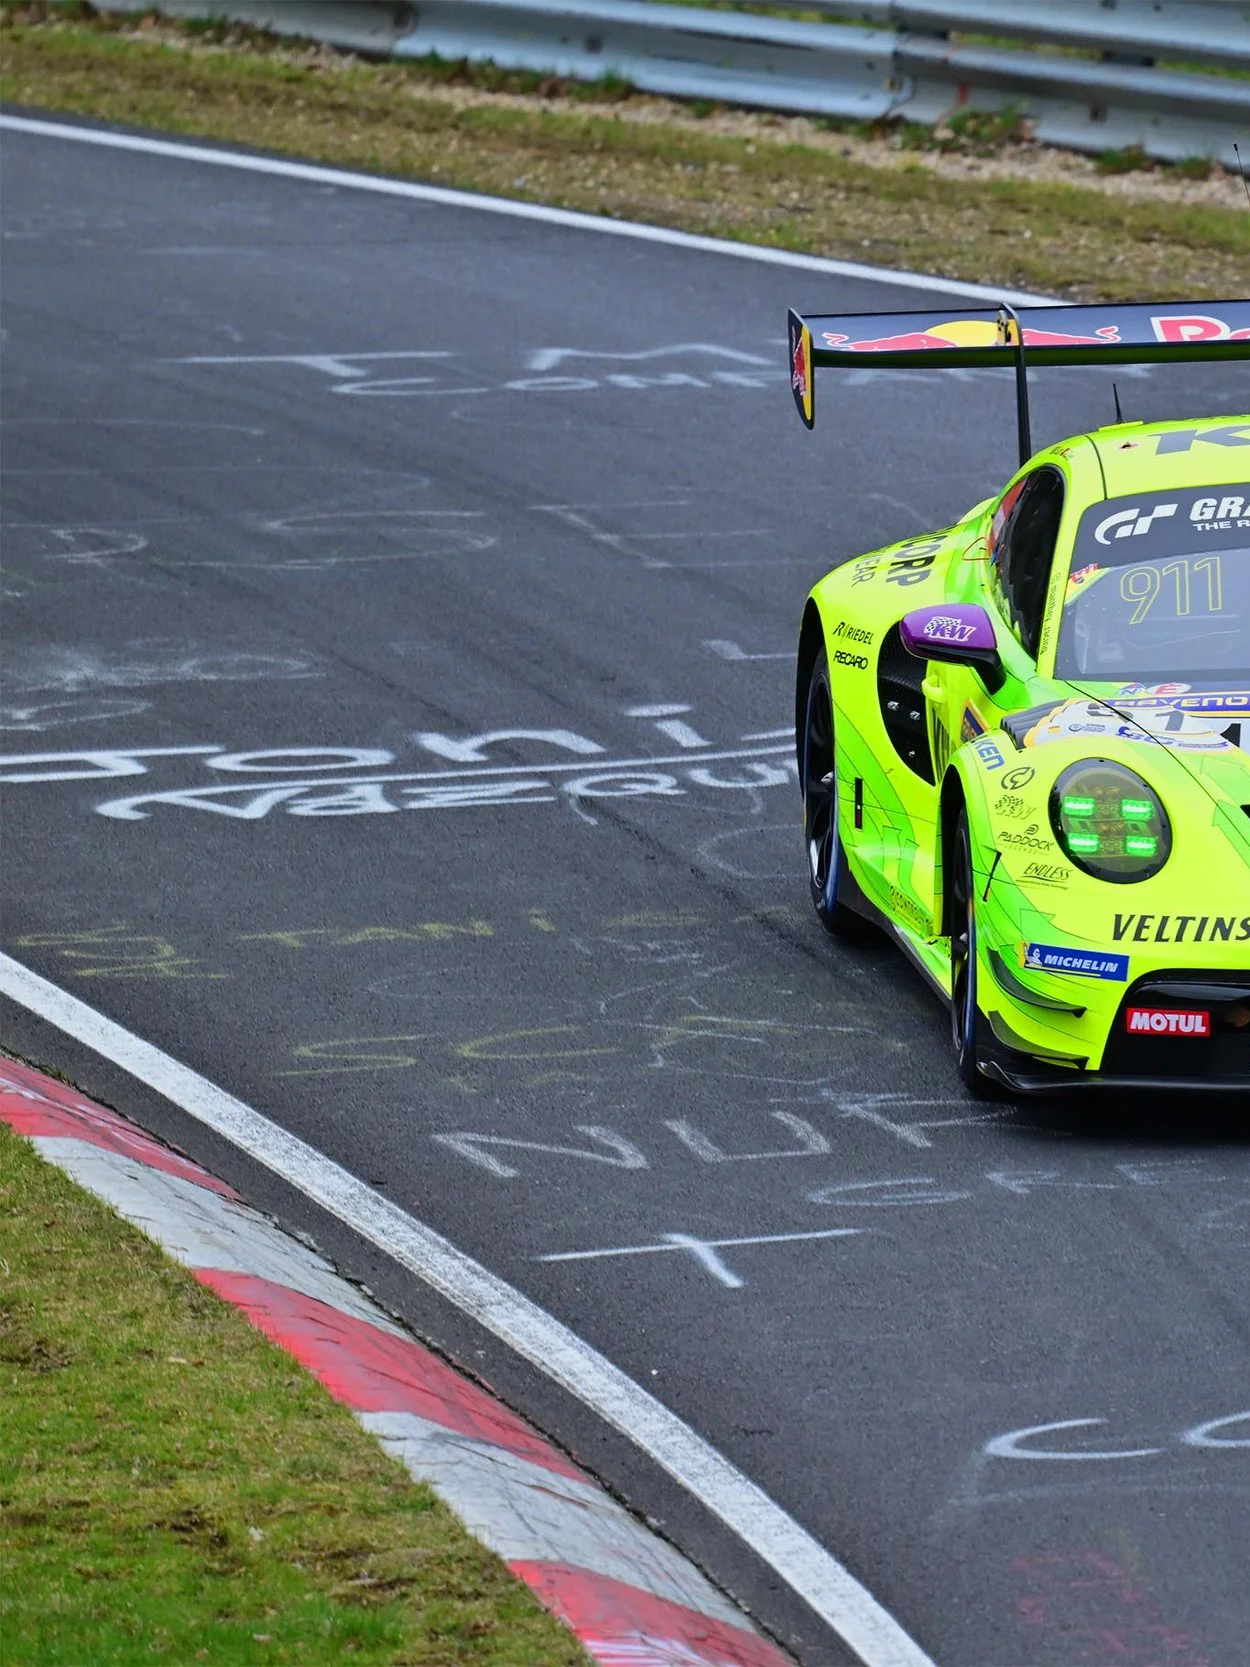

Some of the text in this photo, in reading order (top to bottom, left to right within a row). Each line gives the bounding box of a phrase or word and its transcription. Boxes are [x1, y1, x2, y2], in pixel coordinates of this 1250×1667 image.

[1193, 521, 1233, 532] THE
[1120, 556, 1223, 625] 911
[846, 626, 874, 646] RIEDEL
[929, 622, 976, 642] KW
[833, 650, 869, 670] RECARO
[997, 831, 1055, 850] PADDOCK
[1023, 862, 1073, 881] ENDLESS
[1043, 954, 1119, 973] MICHELIN
[1130, 1011, 1207, 1034] MOTUL
